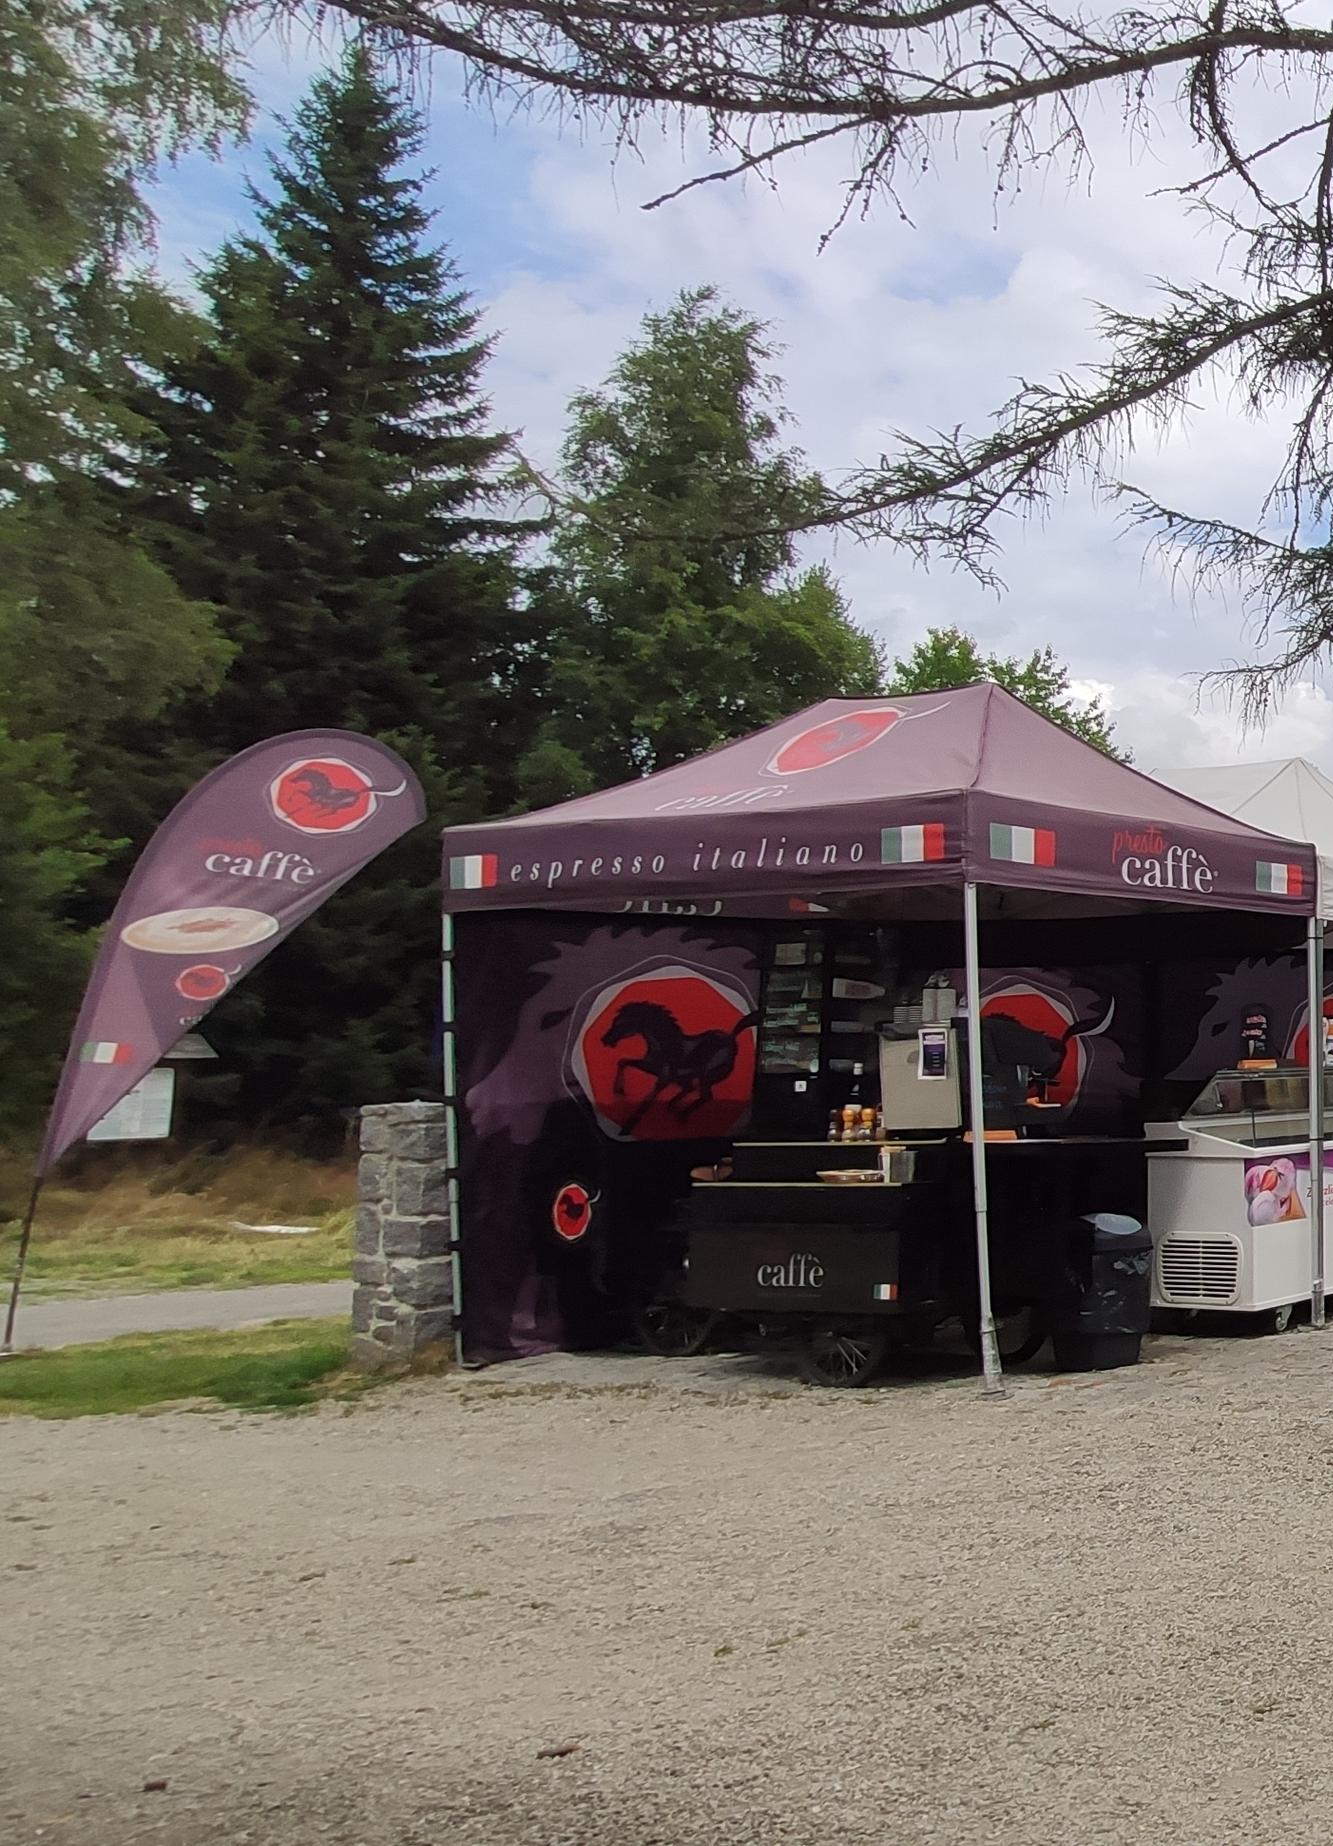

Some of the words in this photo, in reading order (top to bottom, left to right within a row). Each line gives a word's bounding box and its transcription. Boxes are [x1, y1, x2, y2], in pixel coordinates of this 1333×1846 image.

[510, 854, 666, 889] espresso
[692, 837, 865, 872] italiano
[1111, 825, 1166, 865] presto
[204, 850, 315, 884] caffè
[1121, 845, 1214, 894] caffè
[757, 1252, 825, 1288] caffè
